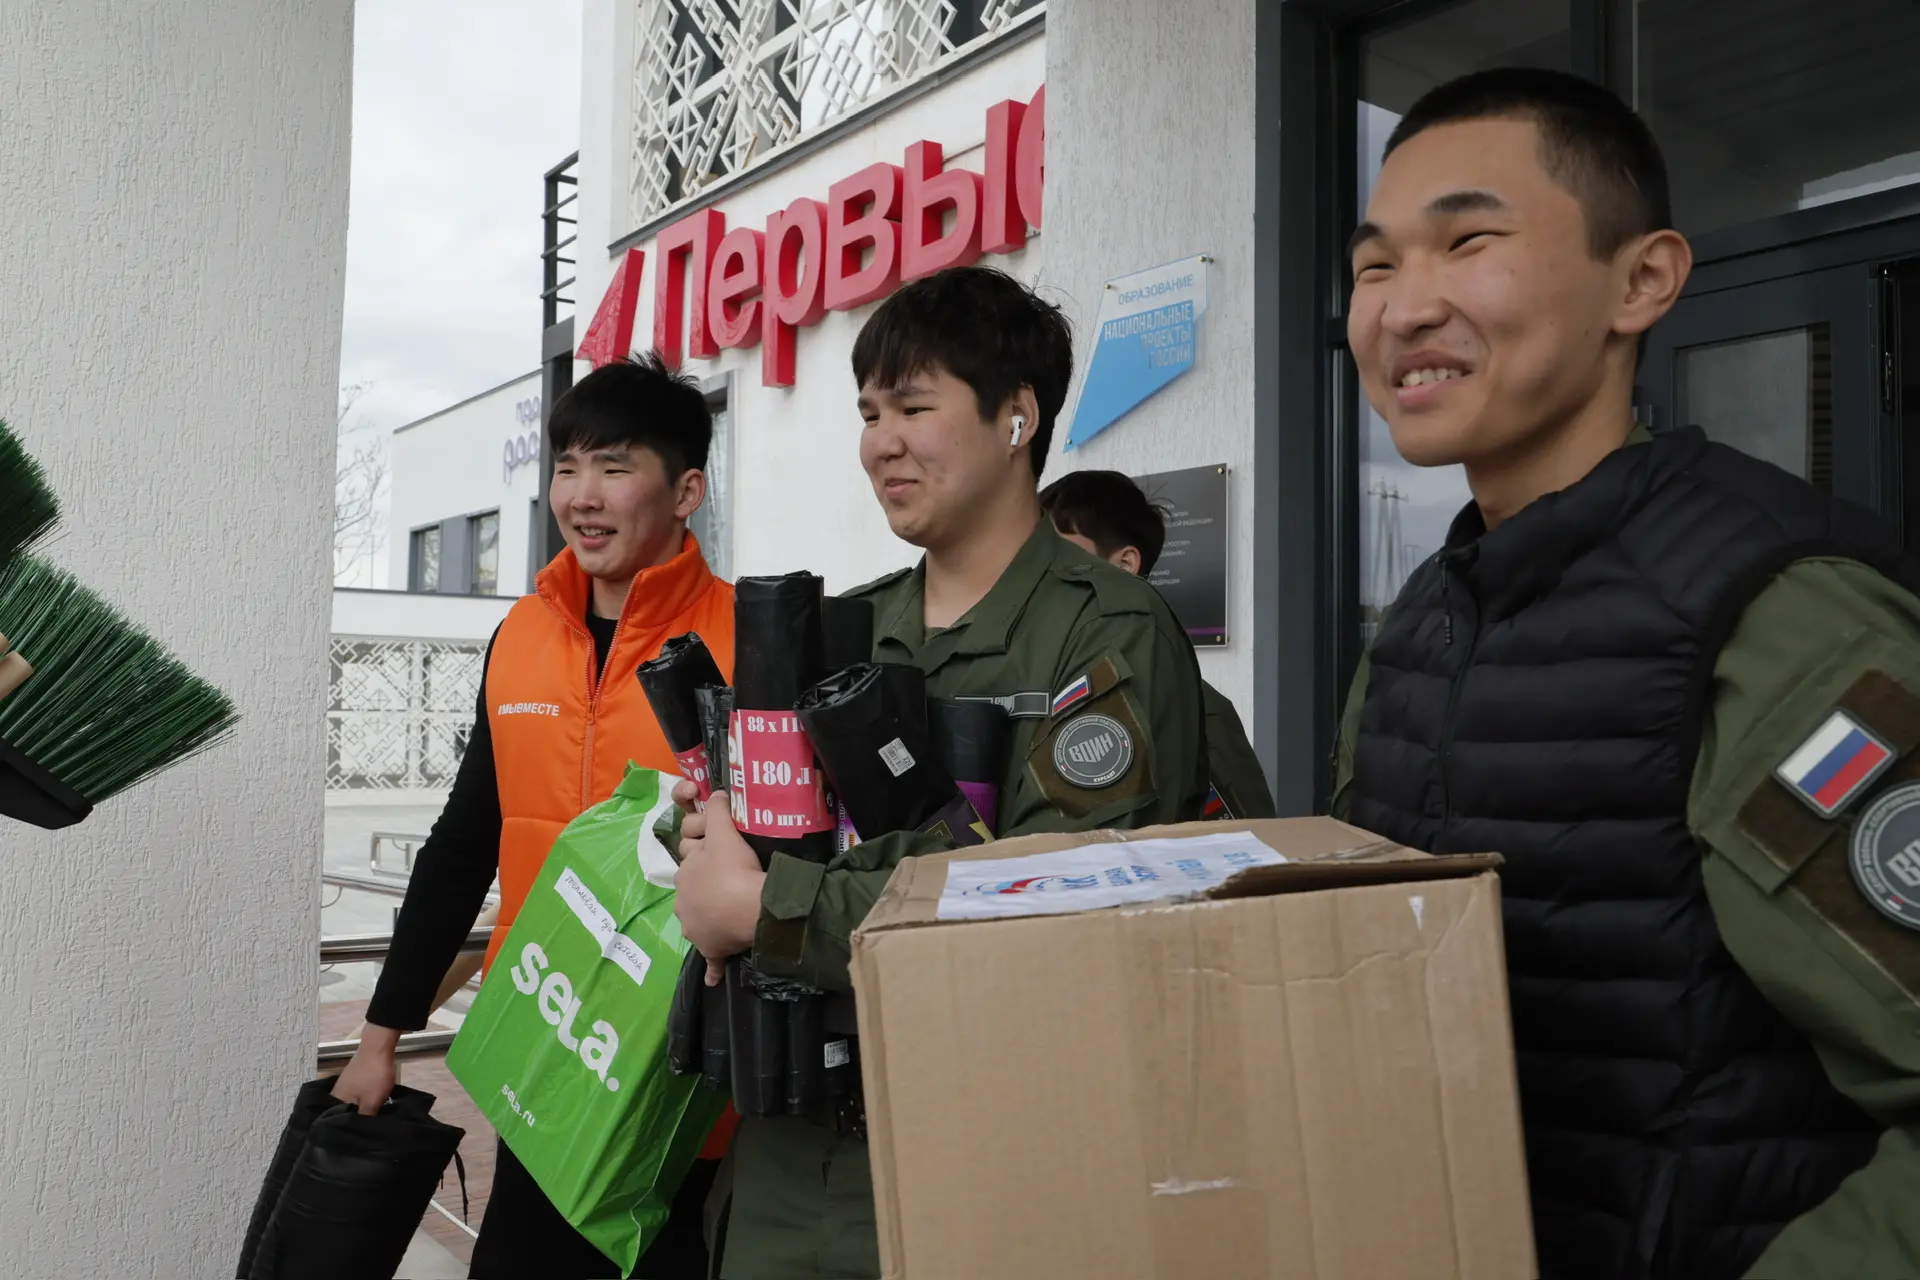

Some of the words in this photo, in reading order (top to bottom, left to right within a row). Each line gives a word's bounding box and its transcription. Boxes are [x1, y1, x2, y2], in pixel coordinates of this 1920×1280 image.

[1118, 274, 1194, 305] ОБРАЗОВАНИЕ
[1104, 304, 1193, 341] НАЦИОНАЛЬНЫЕ
[1142, 324, 1192, 348] ПРОЕКТЫ
[747, 716, 764, 733] 88
[1068, 732, 1114, 763] ВОИН
[751, 760, 792, 786] 180
[796, 767, 811, 786] л
[1093, 770, 1116, 783] КУРСАНТ
[754, 808, 774, 825] 10
[776, 814, 812, 826] шт.
[510, 942, 620, 1092] sela.
[501, 1084, 536, 1128] sela.ru
